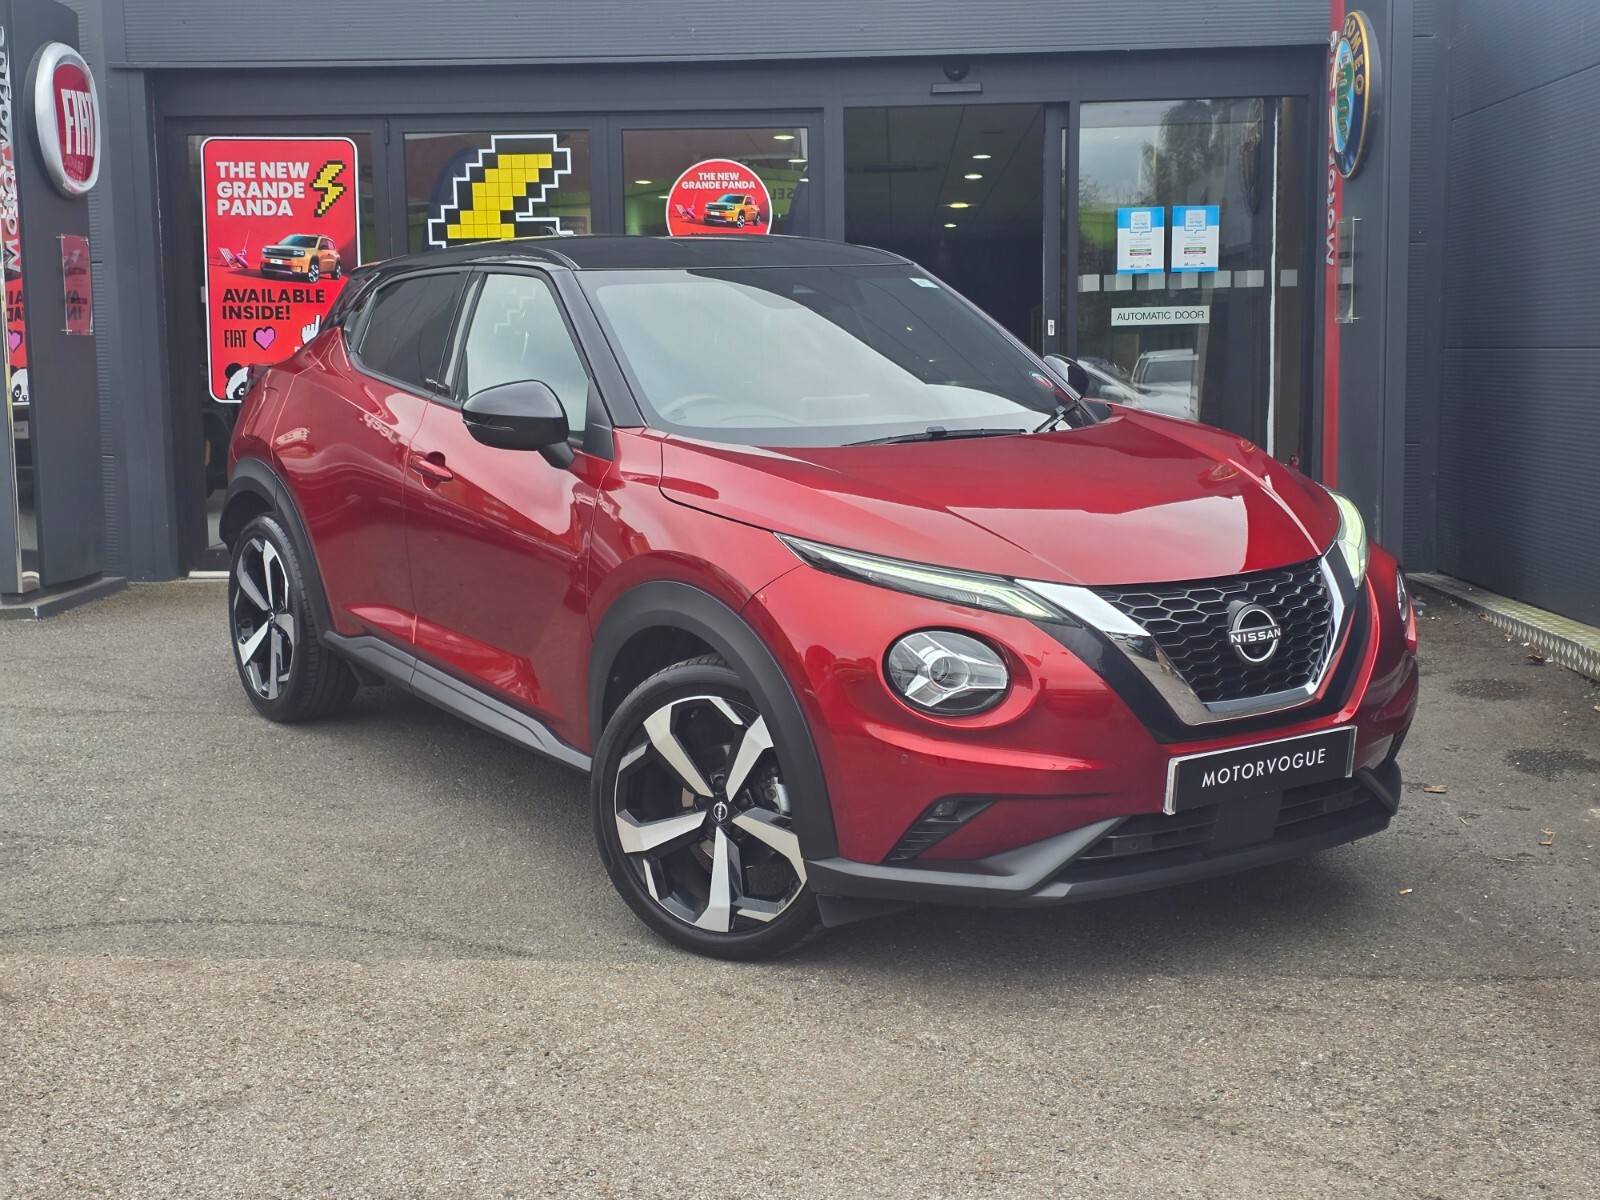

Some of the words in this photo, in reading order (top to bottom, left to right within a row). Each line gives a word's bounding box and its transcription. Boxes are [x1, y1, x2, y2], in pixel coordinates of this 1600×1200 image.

[61, 88, 94, 157] FIAT
[216, 161, 256, 178] THE
[260, 161, 310, 179] NEW
[698, 172, 716, 181] THE
[717, 172, 740, 181] NEW
[216, 181, 305, 199] GRANDE
[681, 181, 721, 190] GRANDE
[722, 181, 756, 190] PANDA
[217, 199, 294, 216] PANDA
[222, 288, 326, 304] AVAILABLE
[222, 305, 291, 320] INSIDE!
[1116, 311, 1171, 321] AUTOMATIC
[1174, 310, 1205, 320] DOOR
[224, 329, 247, 348] FIAT
[1230, 627, 1282, 644] NISSAN
[1201, 748, 1326, 788] MOTORVOGUE
